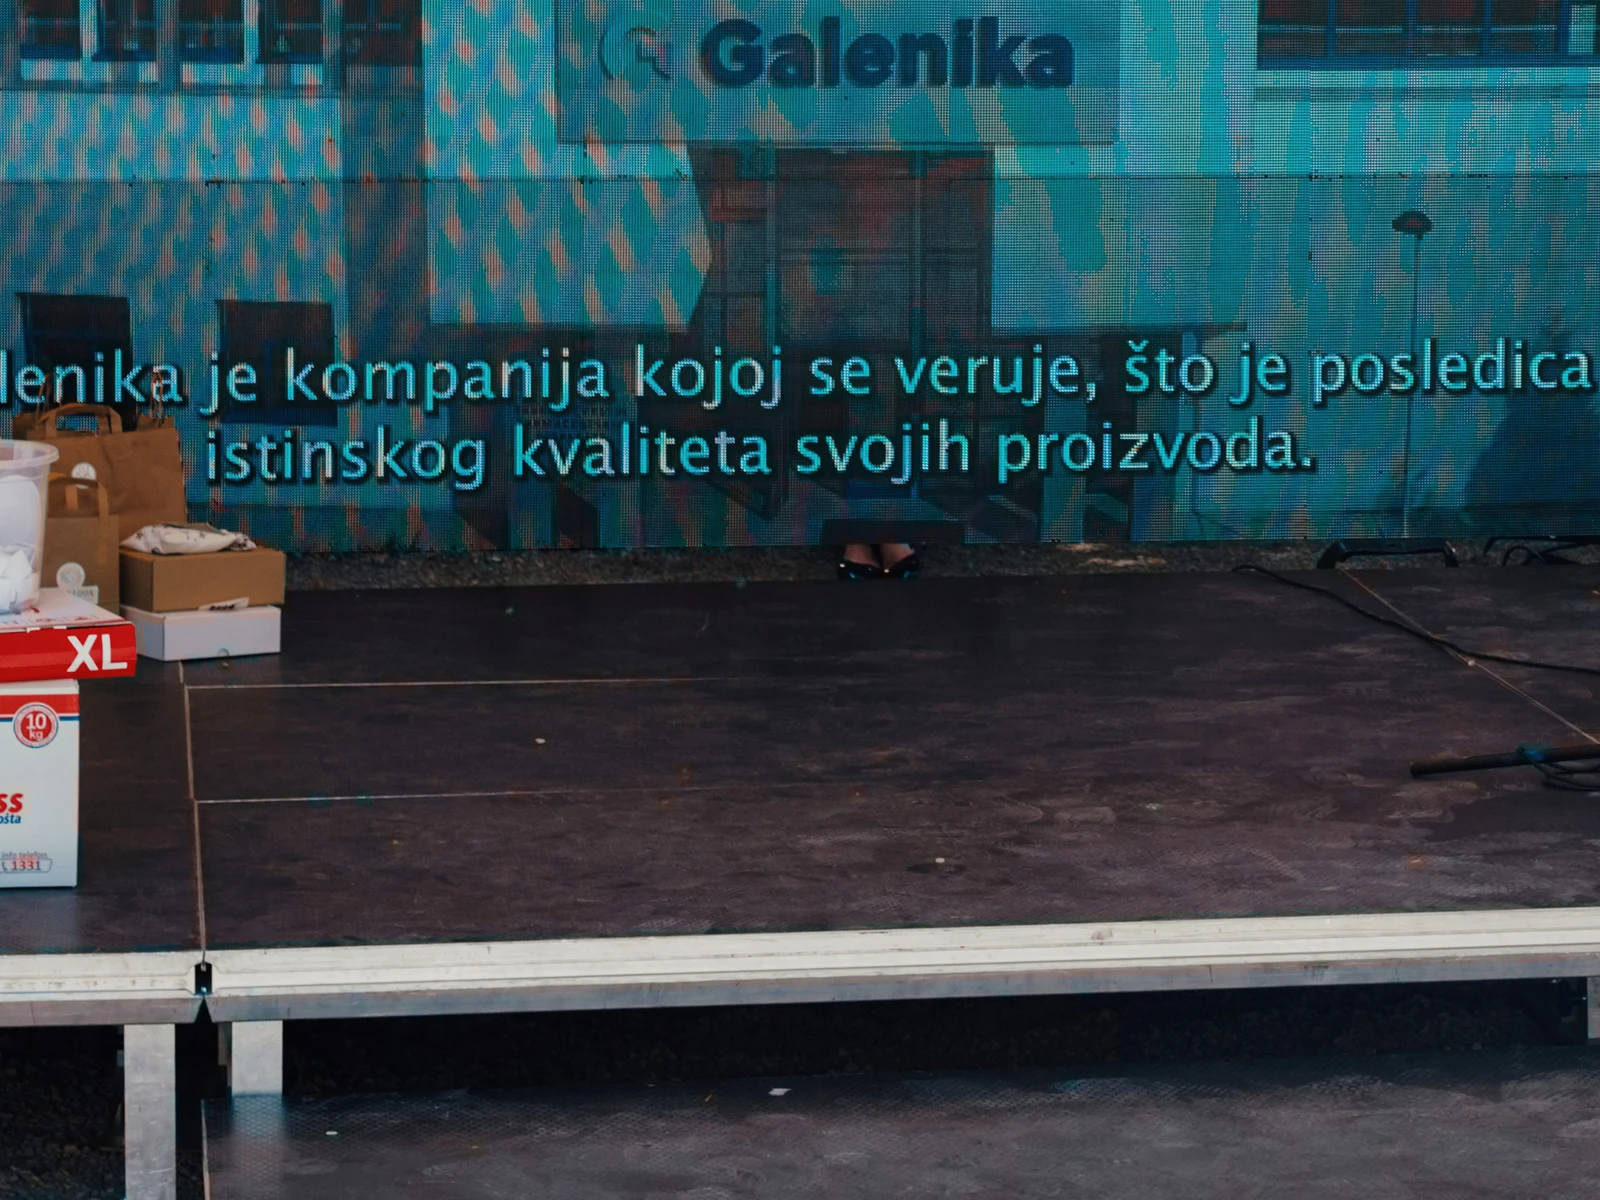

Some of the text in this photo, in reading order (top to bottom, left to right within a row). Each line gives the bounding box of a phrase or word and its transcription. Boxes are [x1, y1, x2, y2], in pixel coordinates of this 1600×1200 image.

[701, 15, 1076, 89] Galenika
[200, 349, 257, 416] je
[287, 345, 610, 413] kompanija
[634, 343, 783, 411] kojoj
[809, 355, 871, 396] se
[894, 343, 1097, 407] veruje,
[1124, 338, 1215, 394] što
[1228, 341, 1288, 405] je
[1312, 337, 1593, 404] posledica
[208, 415, 1313, 492] istinskog kvaliteta svojih proizvoda.
[66, 633, 128, 673] XL
[25, 712, 48, 730] 10
[29, 729, 45, 744] kg
